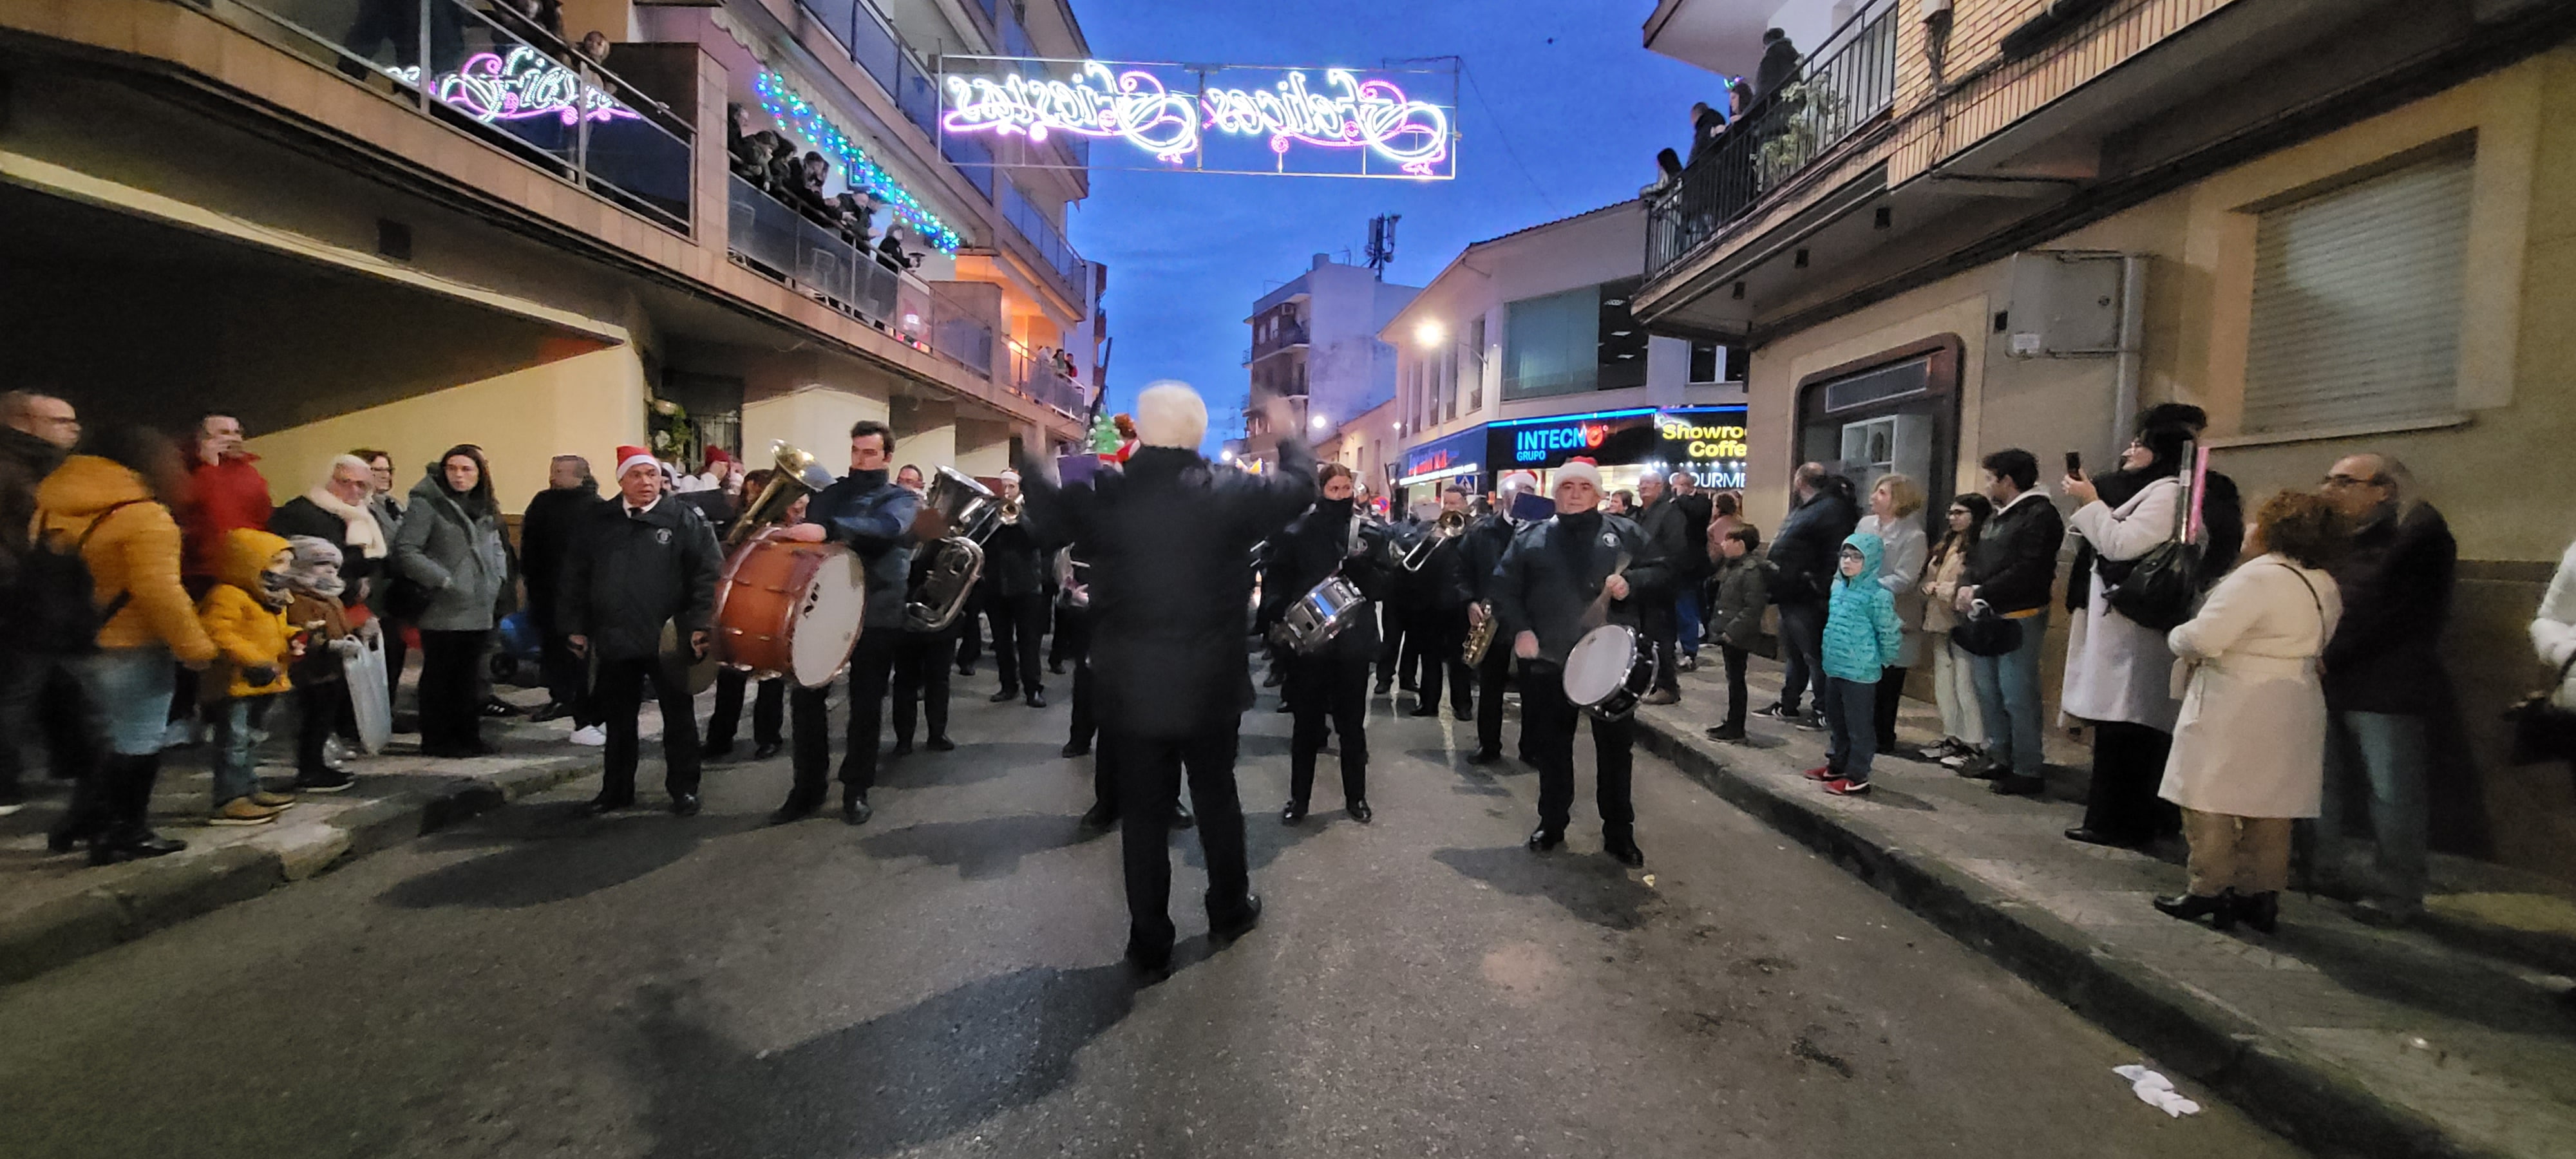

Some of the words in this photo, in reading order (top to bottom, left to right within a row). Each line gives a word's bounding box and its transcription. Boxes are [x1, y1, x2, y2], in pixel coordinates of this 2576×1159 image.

[1517, 426, 1604, 450] INTECNO
[1663, 424, 1747, 439] Showro
[1517, 450, 1546, 462] GRUPO
